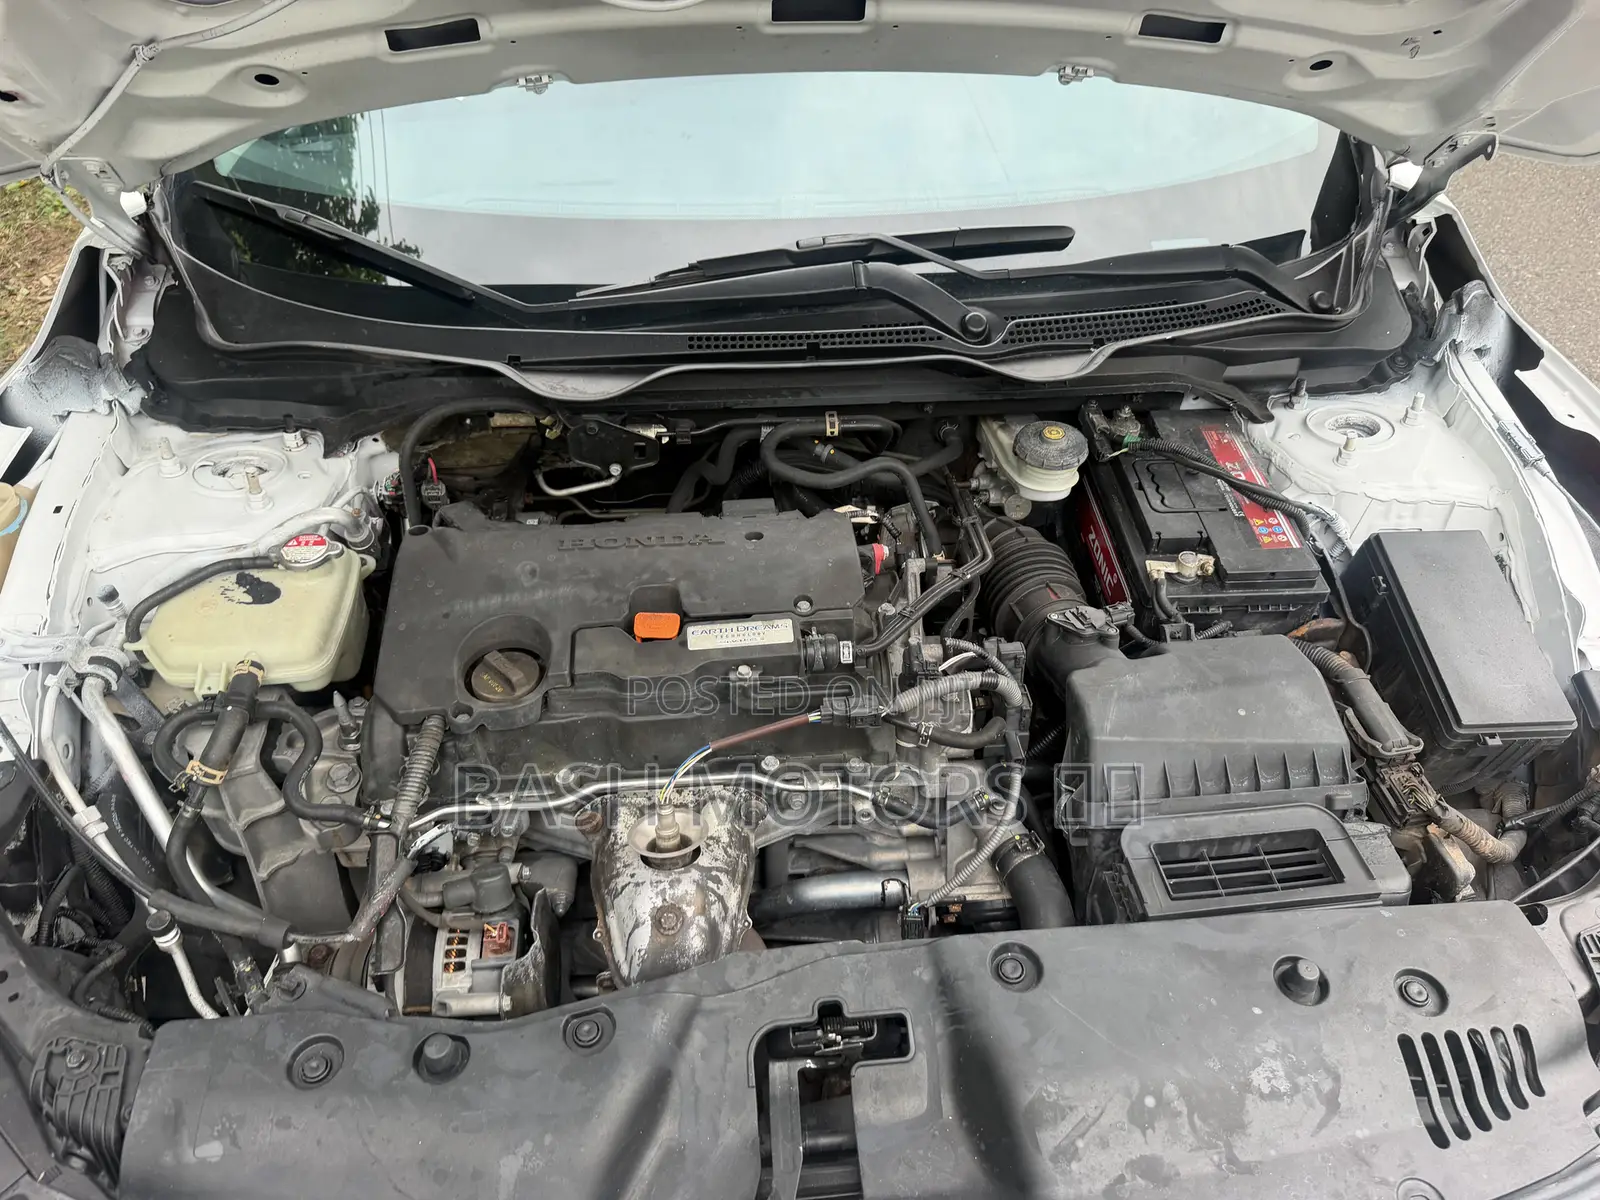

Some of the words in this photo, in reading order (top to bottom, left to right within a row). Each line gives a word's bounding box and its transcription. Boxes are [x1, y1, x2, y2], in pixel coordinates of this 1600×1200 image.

[557, 534, 726, 551] HONDA
[1088, 525, 1114, 597] ZONIC
[691, 627, 734, 636] EARTH
[736, 623, 789, 633] DREAMS
